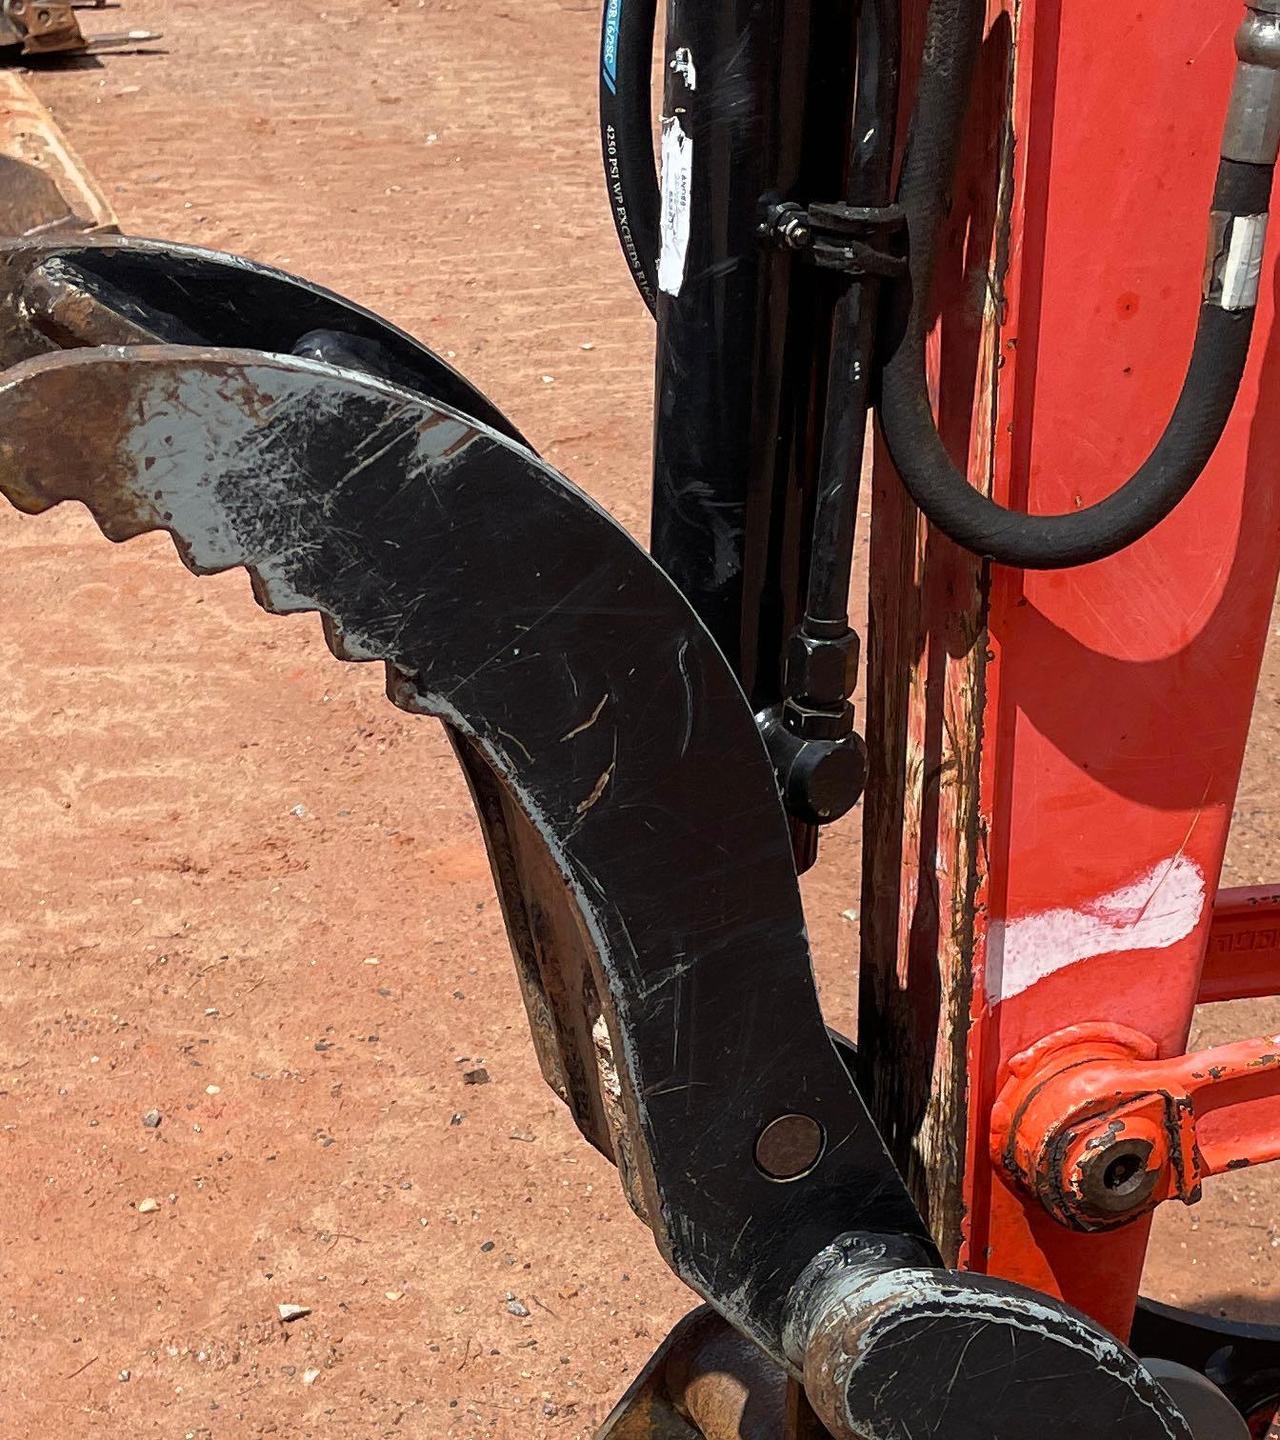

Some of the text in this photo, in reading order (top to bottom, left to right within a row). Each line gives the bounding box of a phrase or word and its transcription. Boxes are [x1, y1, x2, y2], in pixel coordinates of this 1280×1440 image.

[606, 124, 641, 269] 4250 PSI WP EXCEEDS
